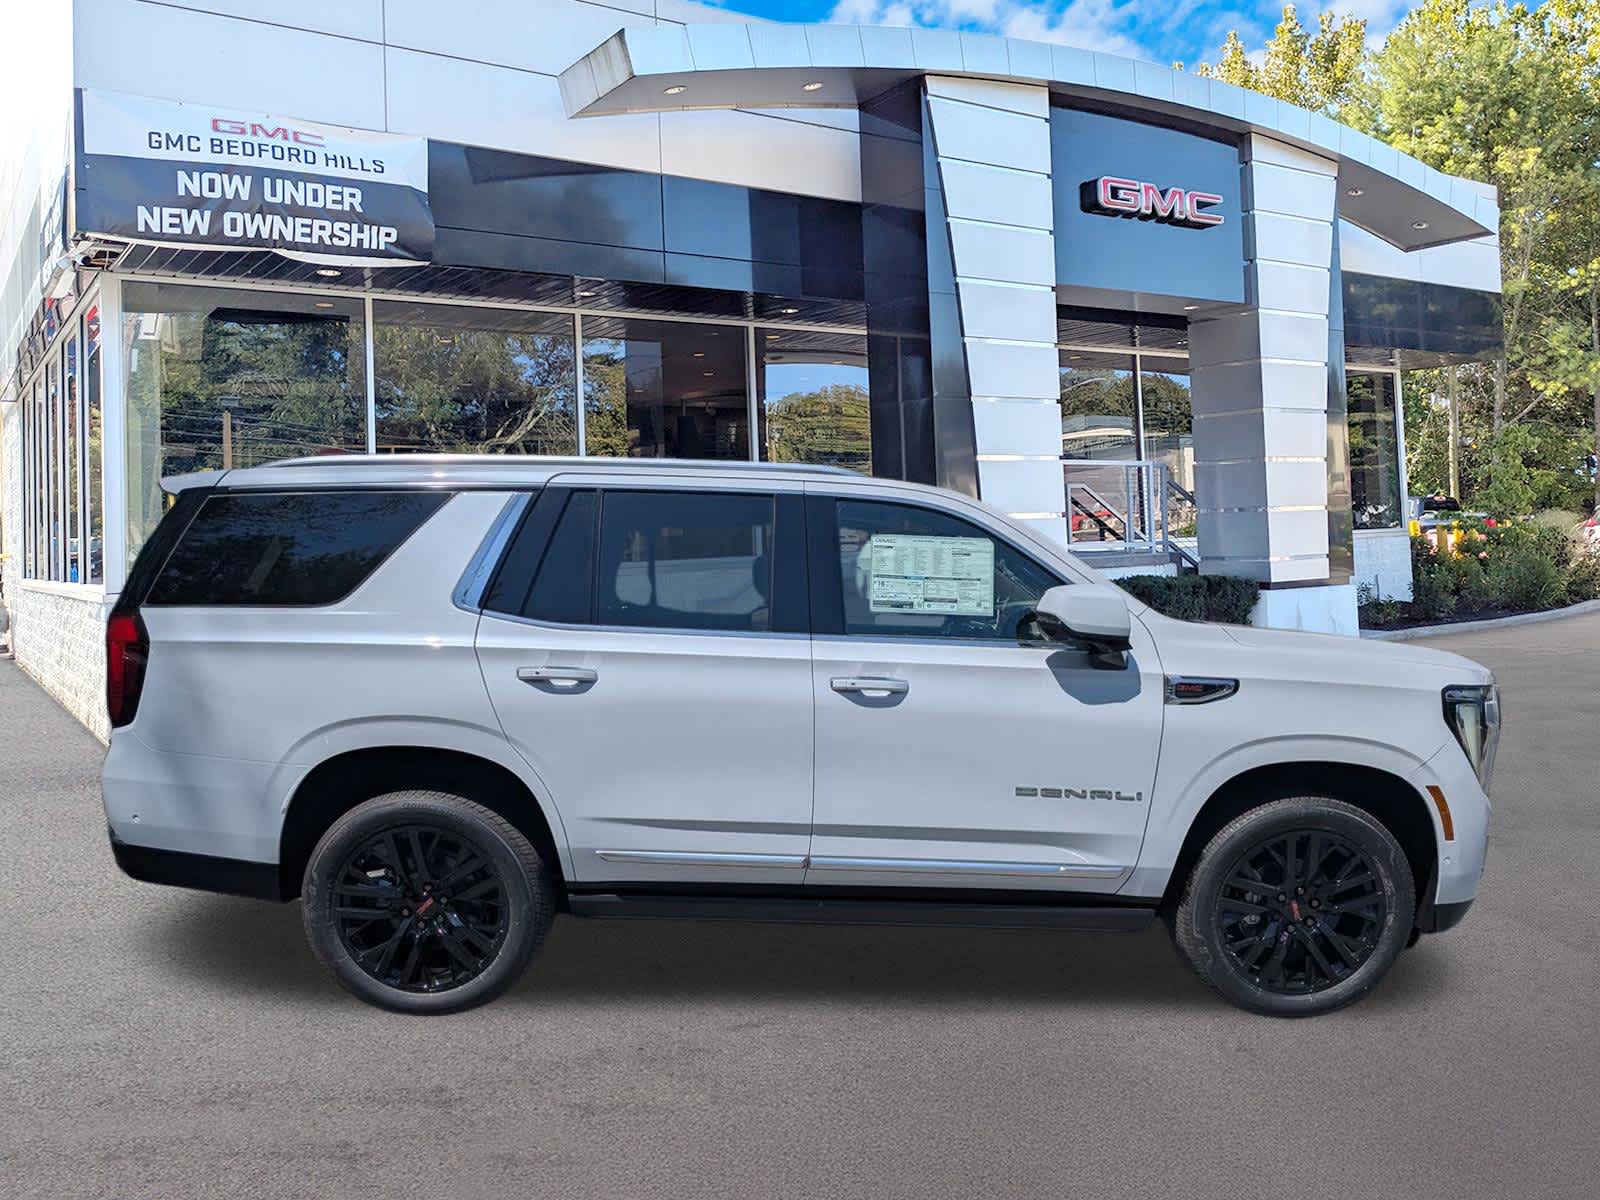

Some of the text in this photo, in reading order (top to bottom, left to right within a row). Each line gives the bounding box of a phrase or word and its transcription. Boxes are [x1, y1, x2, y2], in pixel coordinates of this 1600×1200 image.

[148, 131, 385, 174] GMC BEDFORD HILLS
[212, 118, 326, 148] GMC
[177, 170, 364, 213] NOW UNDER
[1098, 176, 1224, 225] GMC
[136, 205, 398, 250] NEW OWNERSHIP
[1015, 786, 1143, 802] DENALI
